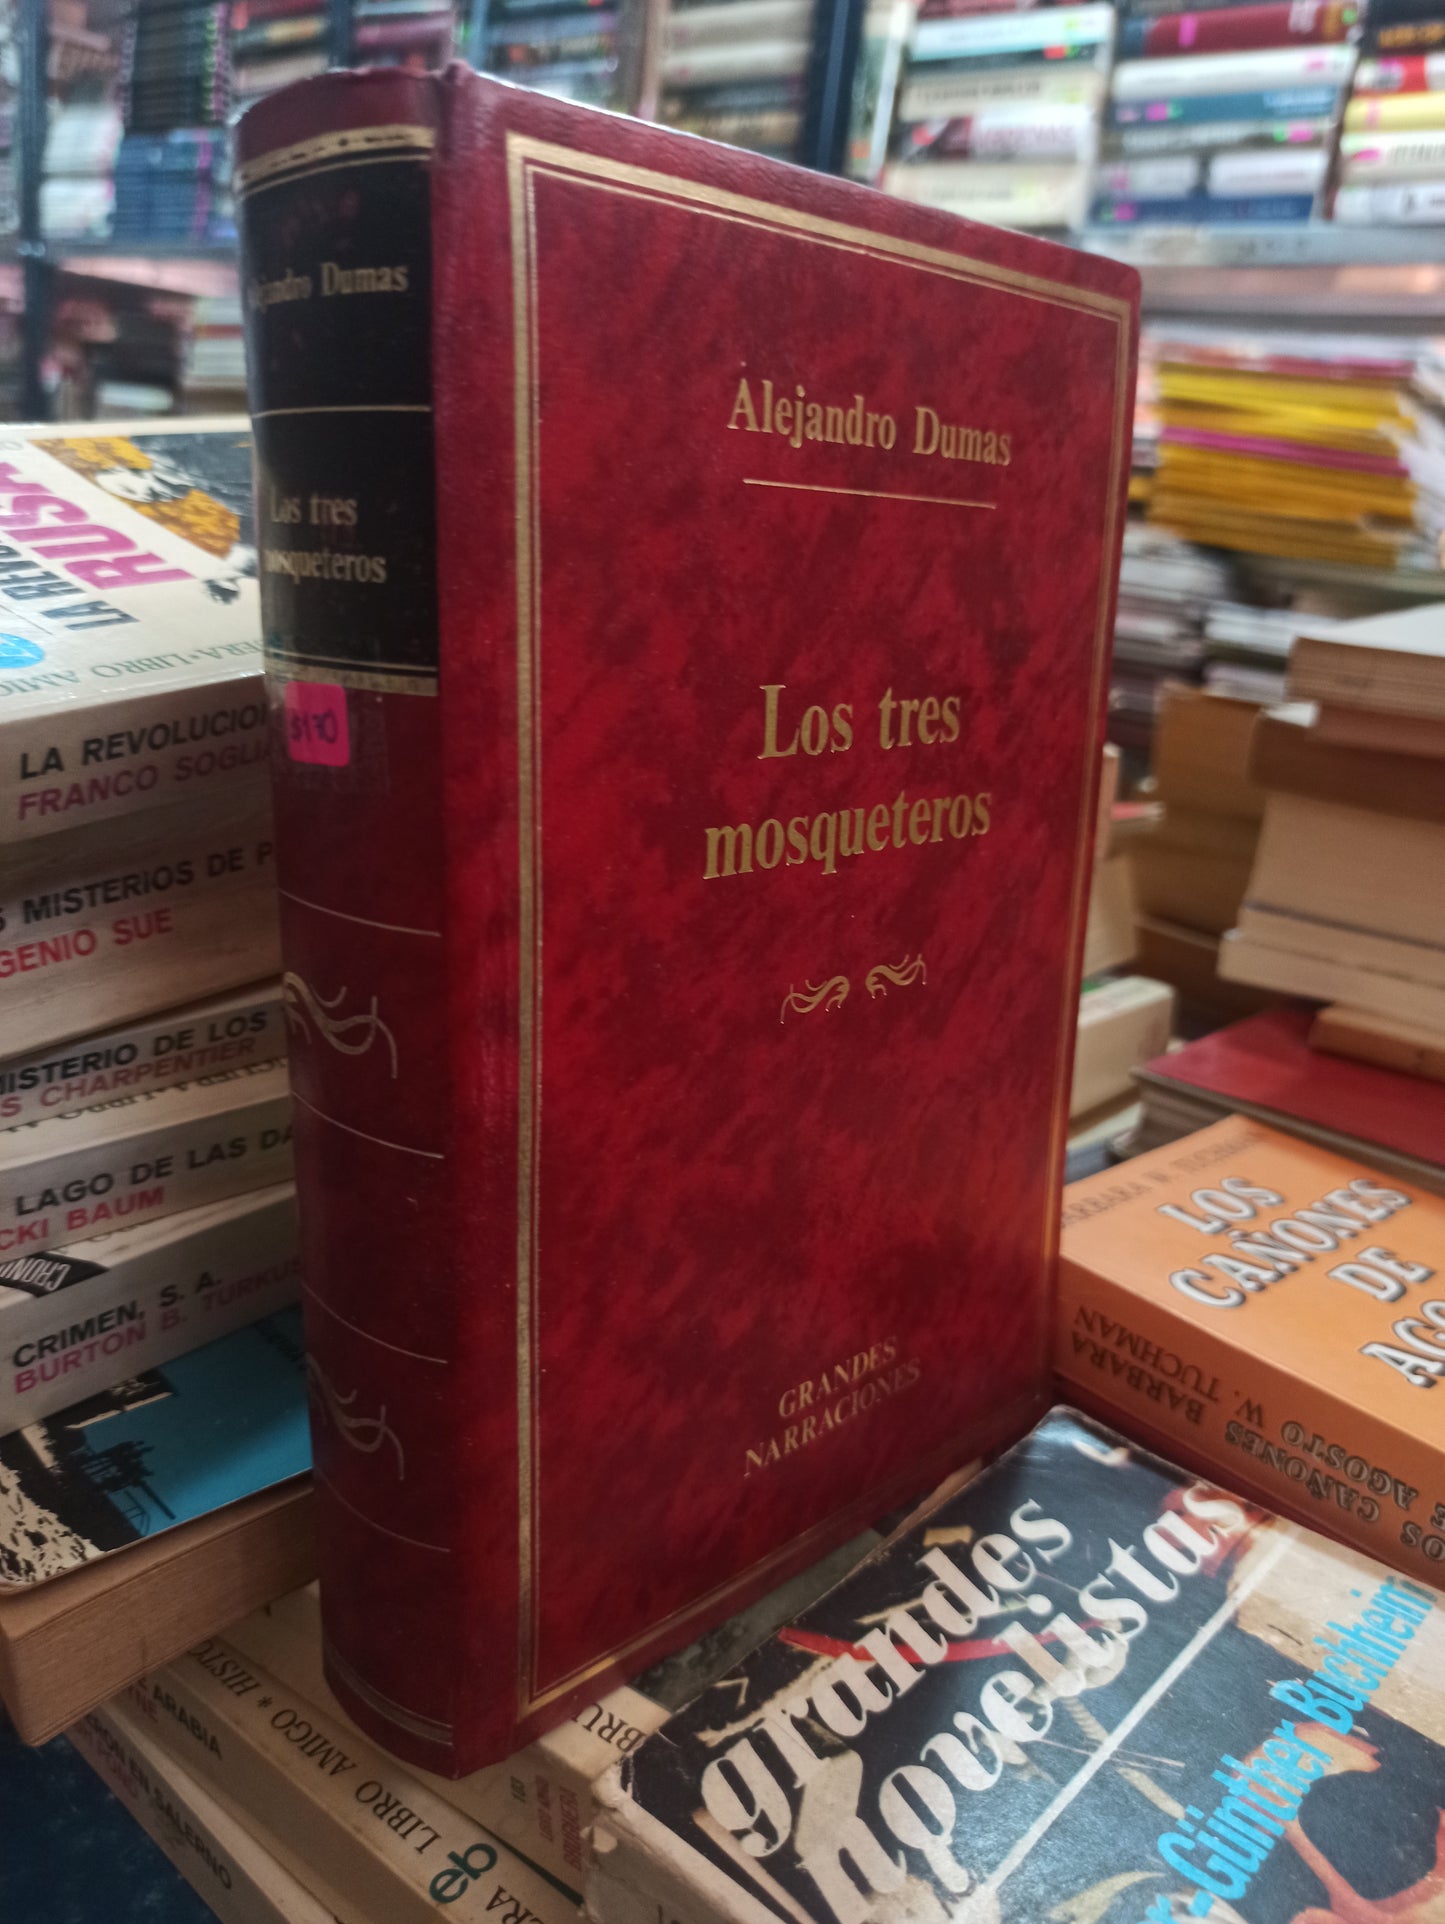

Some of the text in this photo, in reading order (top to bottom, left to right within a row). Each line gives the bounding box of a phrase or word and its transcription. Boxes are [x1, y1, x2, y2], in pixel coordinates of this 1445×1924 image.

[321, 262, 408, 296] Dumas
[727, 377, 1012, 467] Alejandro Dumas
[269, 488, 358, 525] Los tres
[41, 600, 140, 631] LA
[89, 653, 191, 679] LIBRO
[757, 684, 962, 760] Los tres
[18, 765, 159, 820] FRANCO
[20, 747, 65, 780] LA
[703, 791, 992, 879] mosqueteros
[23, 860, 195, 924] MISTERIOS
[207, 849, 245, 878] DE
[112, 907, 173, 946] SUE
[153, 1028, 195, 1056] DE
[209, 1012, 267, 1042] LOS
[40, 1038, 256, 1107] CHARPENTIER
[15, 1173, 114, 1216] LAGO
[130, 1155, 174, 1185] DE
[188, 1137, 248, 1170] LAS
[66, 1186, 165, 1231] BAUM
[1157, 1176, 1285, 1237] LOS
[1169, 1178, 1412, 1309] CAÑONES
[1327, 1246, 1434, 1303] DE
[159, 1284, 185, 1307] S.
[195, 1271, 222, 1294] A.
[14, 1321, 147, 1394] BURTON
[161, 1308, 187, 1334] B.
[778, 1335, 897, 1418] GRANDES
[1072, 1328, 1206, 1426] BARBARA
[1075, 1304, 1220, 1404] TUCHMAN
[743, 1357, 921, 1480] NARRACIONES
[1225, 1420, 1382, 1524] CAÑONES
[1281, 1419, 1418, 1511] AGOSTO
[702, 1498, 1073, 1857] grandes
[1269, 1577, 1437, 1735] Buchheim
[153, 1685, 223, 1761] ARABIA
[797, 1481, 1247, 1924] novelistas
[271, 1707, 357, 1776] AMIGO
[151, 1785, 232, 1891] SALERNO
[355, 1780, 443, 1855] LIBRO
